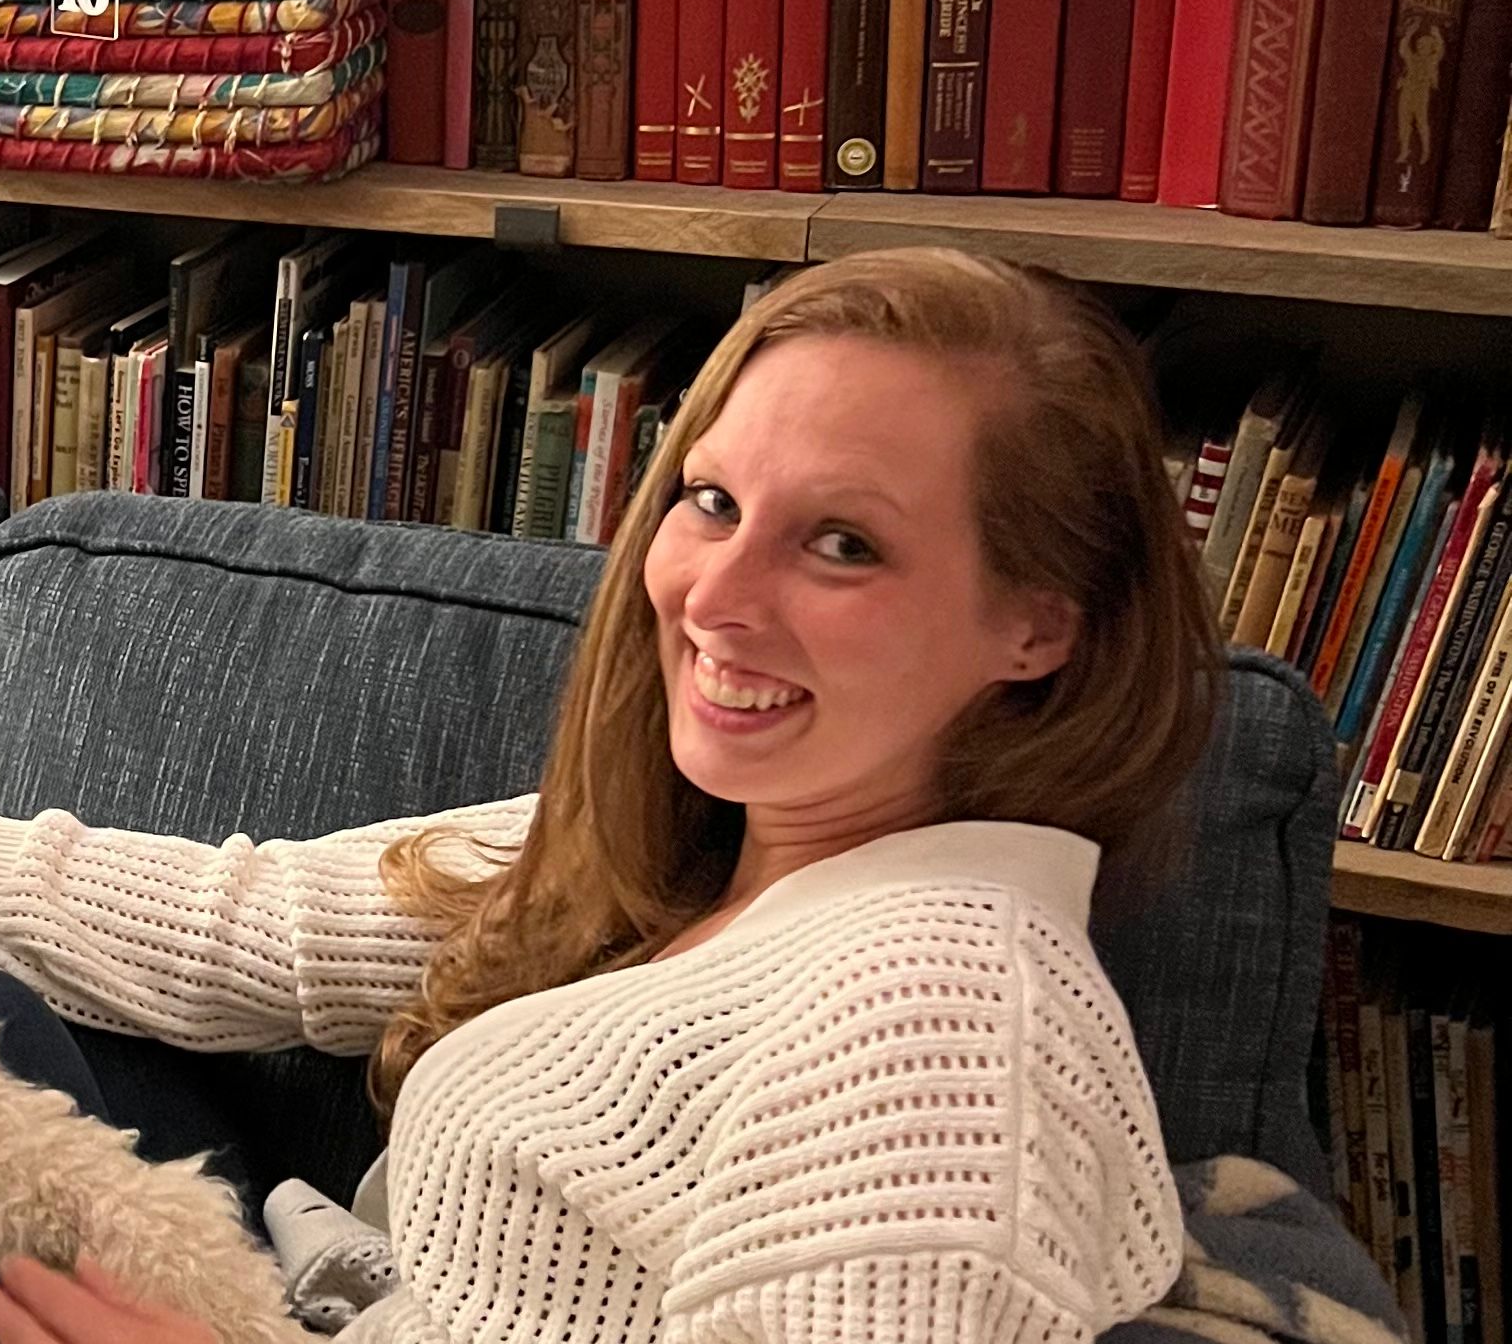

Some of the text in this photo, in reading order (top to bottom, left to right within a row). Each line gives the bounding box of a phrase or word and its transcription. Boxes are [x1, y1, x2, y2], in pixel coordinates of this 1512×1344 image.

[174, 385, 193, 461] HOW TO
[306, 361, 316, 388] MOSS
[387, 328, 415, 511] AMERICA'S HERITAGE
[1443, 522, 1507, 667] GEORGE WASHINGTON
[1452, 651, 1507, 785] SPIES OF THE REVOLUTION
